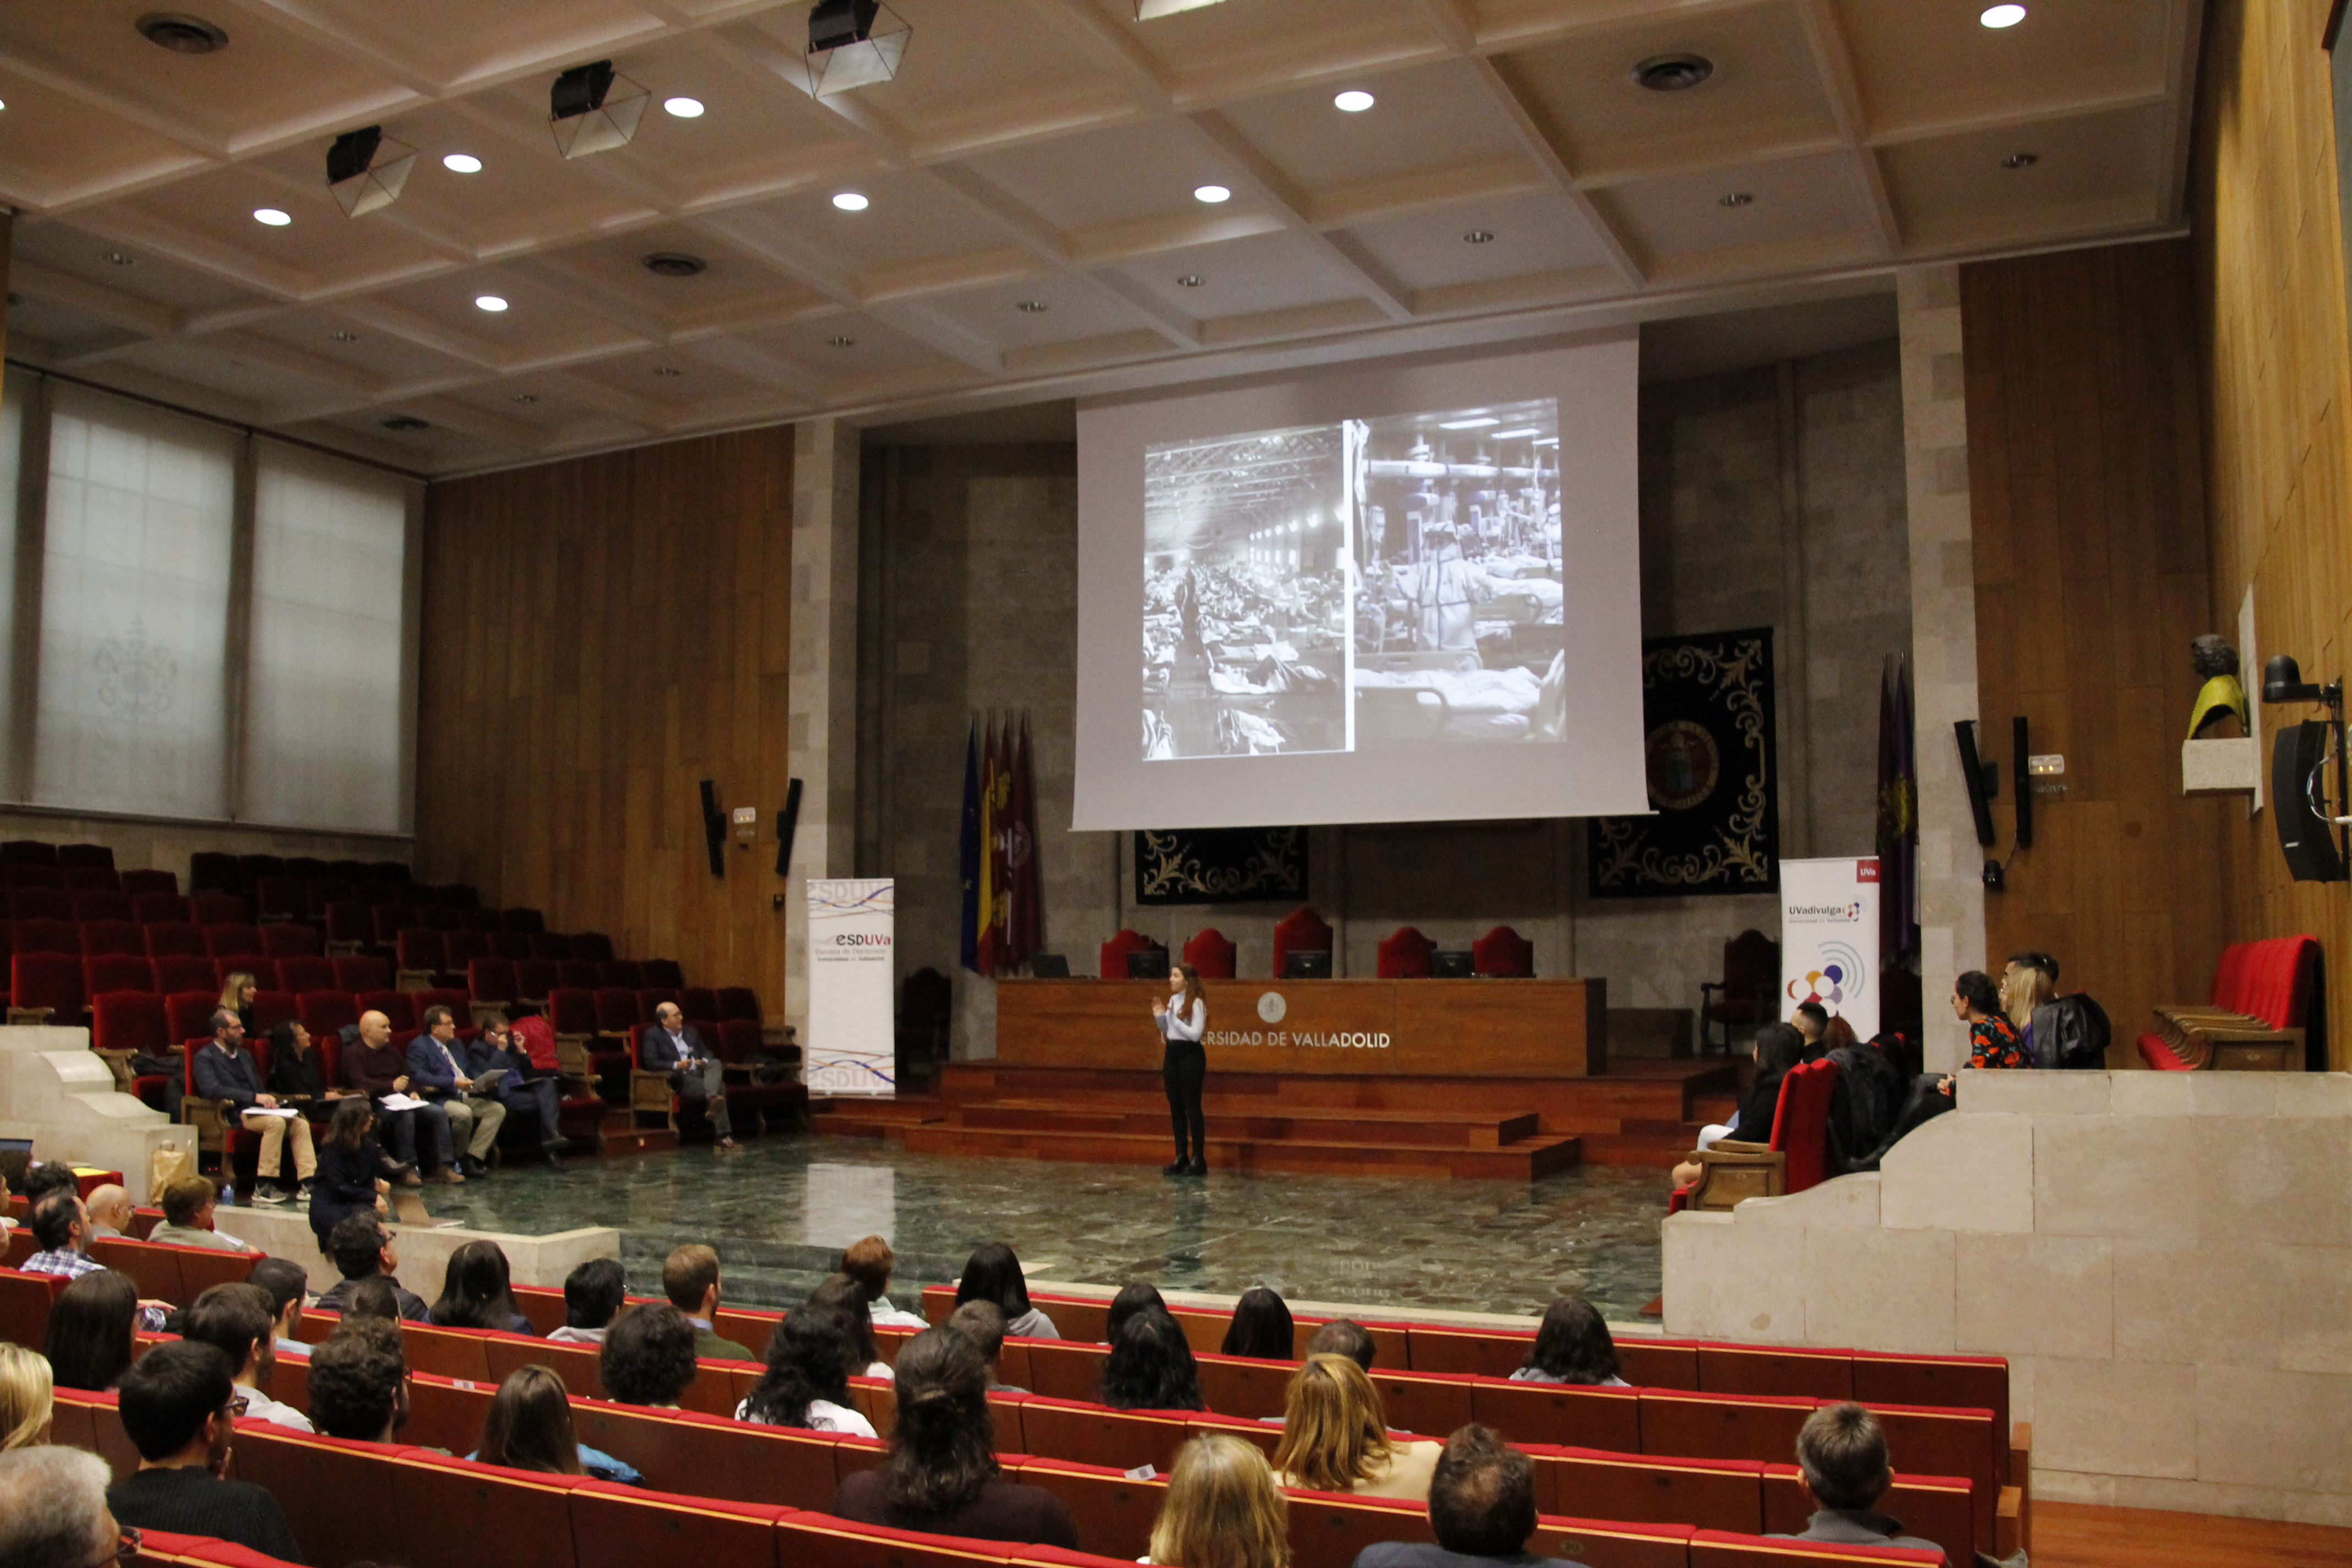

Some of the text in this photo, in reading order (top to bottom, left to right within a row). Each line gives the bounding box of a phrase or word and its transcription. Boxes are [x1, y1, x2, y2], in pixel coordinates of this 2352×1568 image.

[1860, 868, 1876, 876] UVa
[1789, 906, 1841, 915] UVadivulga
[1267, 1031, 1287, 1046] DE
[1292, 1031, 1391, 1049] VALLADOLID
